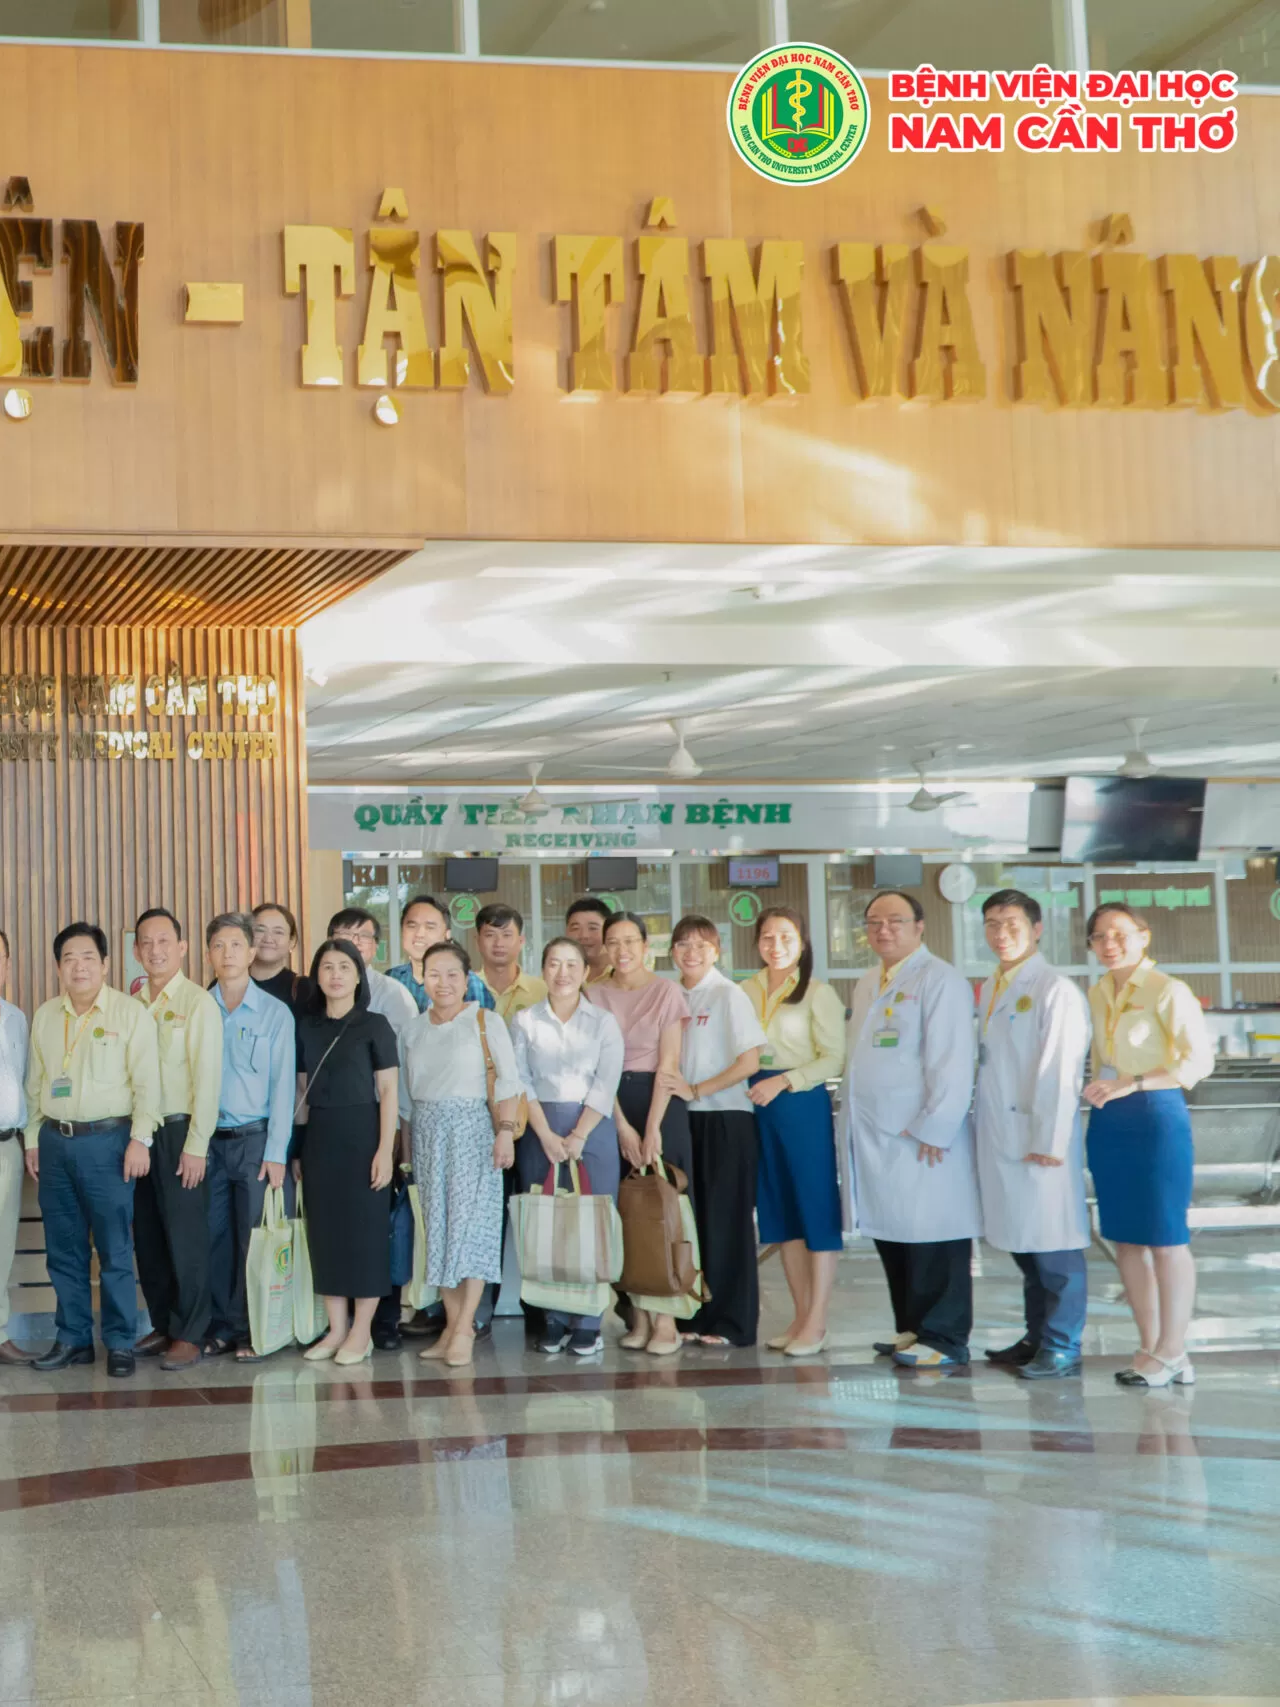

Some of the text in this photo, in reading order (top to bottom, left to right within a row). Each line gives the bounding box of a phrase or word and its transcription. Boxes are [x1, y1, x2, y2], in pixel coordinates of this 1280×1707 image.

[283, 186, 518, 427] TẬN
[553, 195, 812, 398] TÂM
[830, 205, 988, 402] VÀ
[70, 731, 177, 760] MEDICAL
[188, 731, 279, 760] CENTER
[354, 796, 449, 833] QUẦY
[685, 797, 792, 829] BỆNH
[505, 833, 638, 848] RECEIVING
[736, 867, 770, 880] 1196
[455, 898, 476, 921] 2
[734, 895, 753, 921] 4
